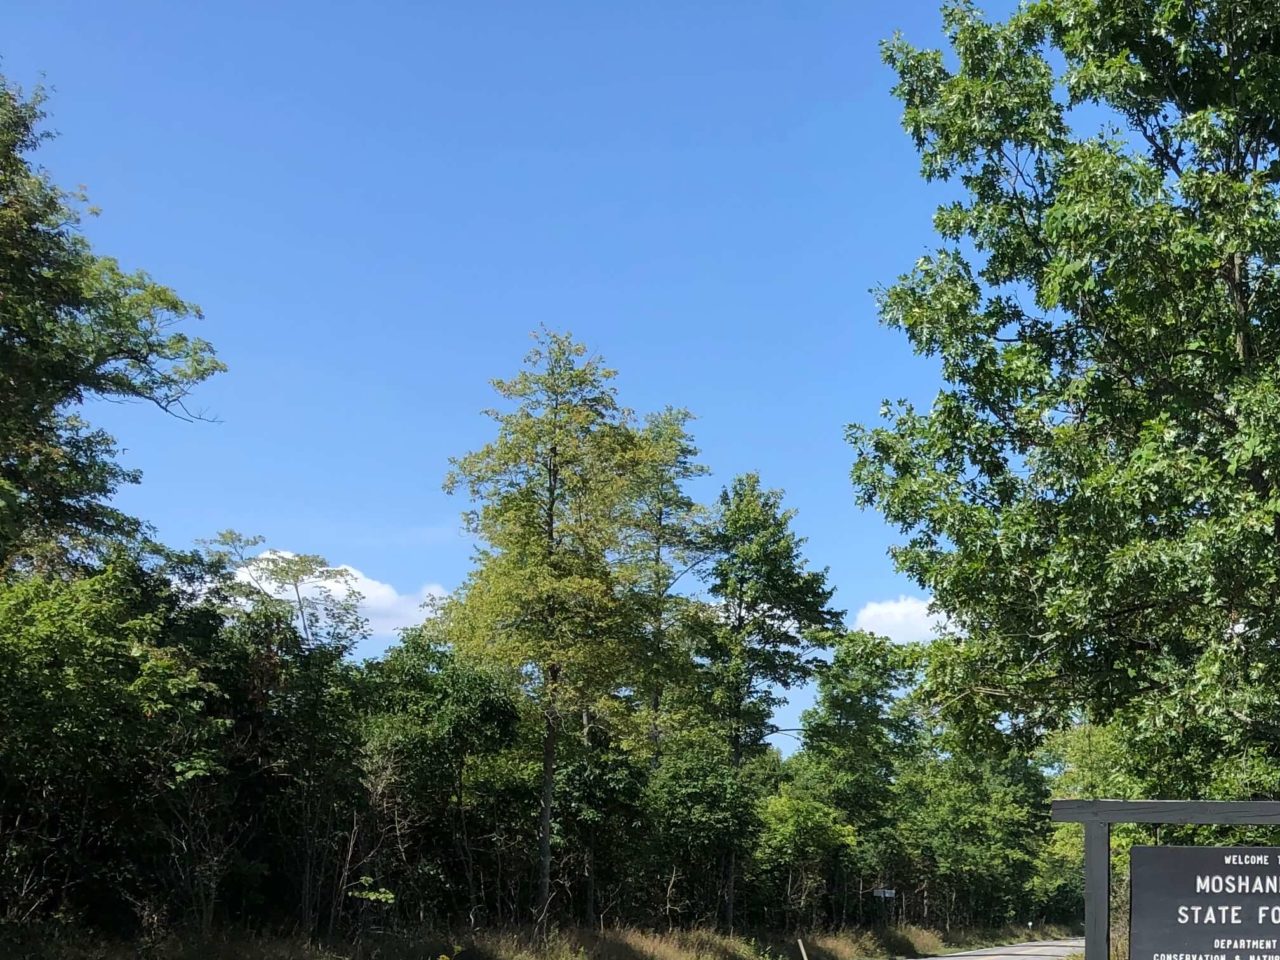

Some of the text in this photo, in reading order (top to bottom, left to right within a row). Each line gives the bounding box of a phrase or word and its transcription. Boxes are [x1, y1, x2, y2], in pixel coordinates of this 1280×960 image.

[1224, 855, 1270, 865] WELCOME
[1177, 906, 1242, 924] STATE
[1213, 939, 1277, 949] DEPARTMENT
